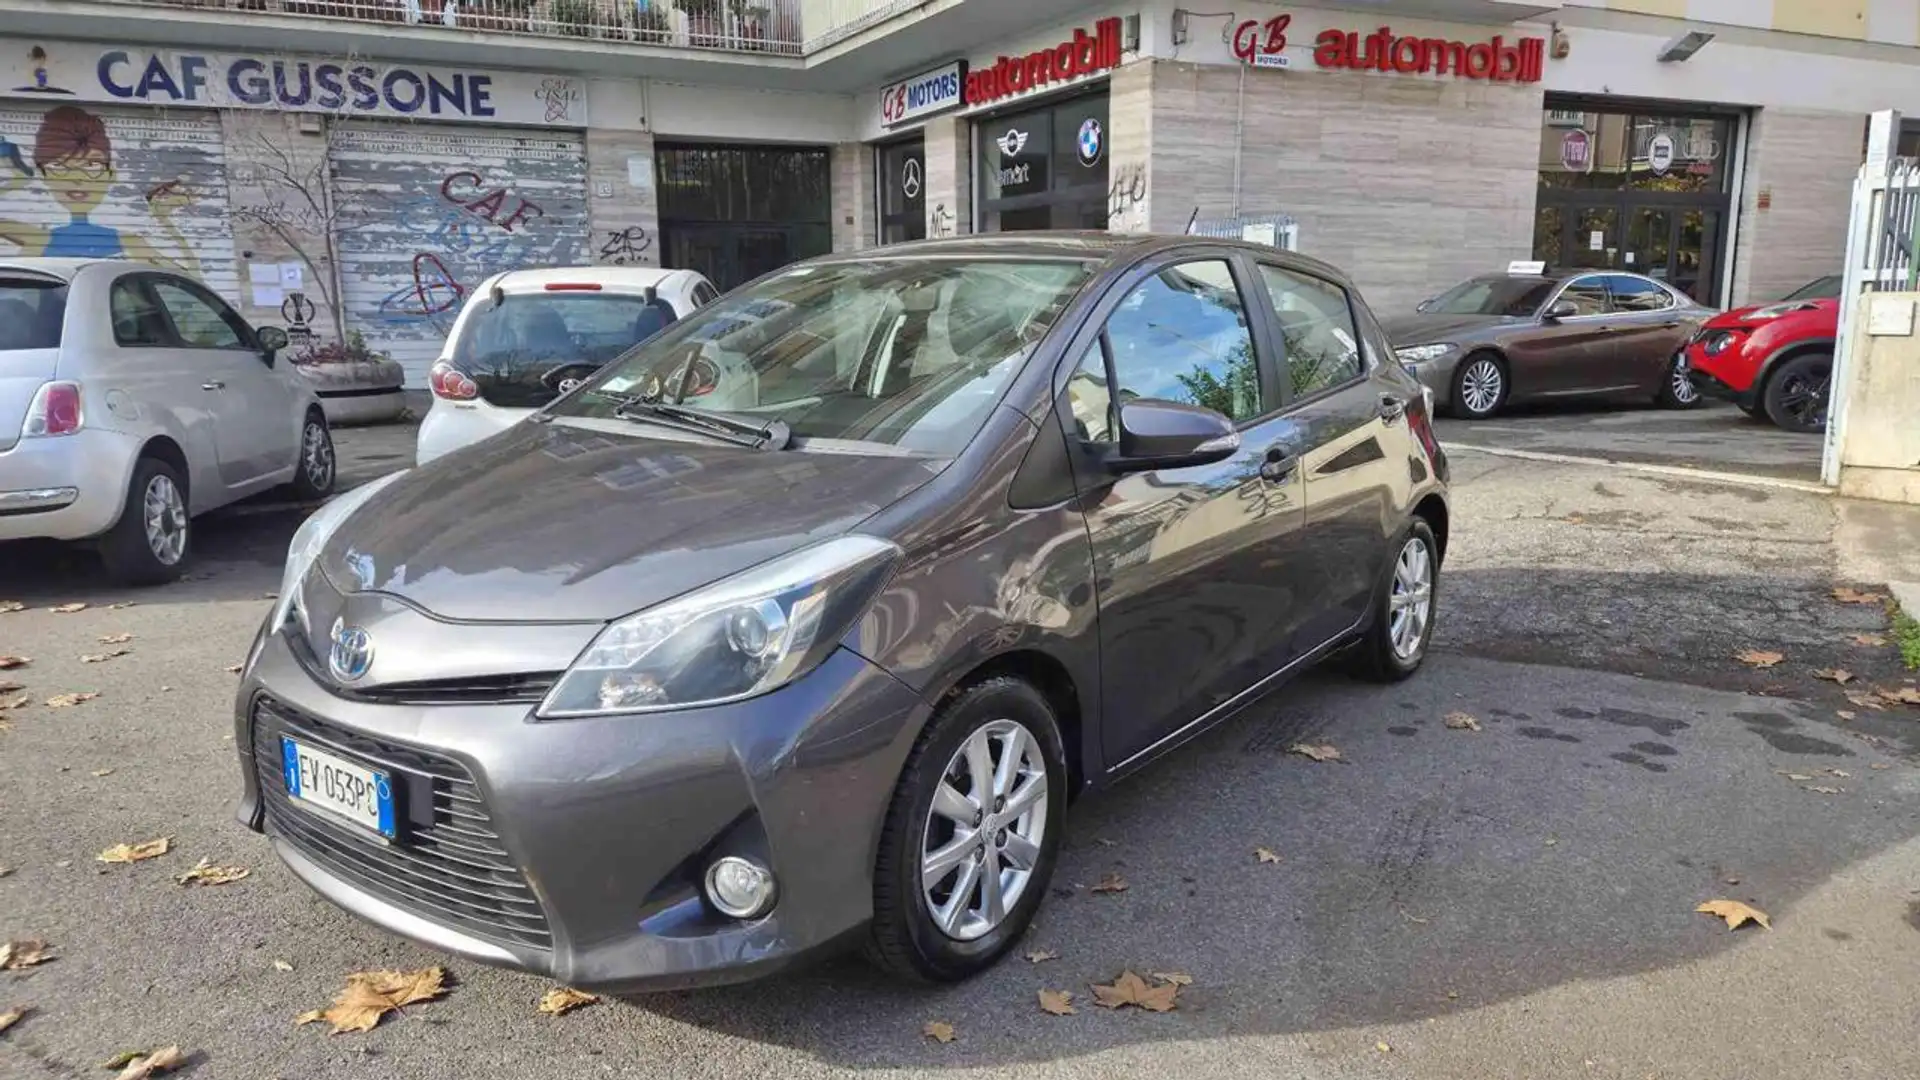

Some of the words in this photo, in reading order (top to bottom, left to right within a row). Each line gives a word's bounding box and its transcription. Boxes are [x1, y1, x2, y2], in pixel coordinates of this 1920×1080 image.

[97, 51, 207, 100] CAF
[226, 59, 496, 117] GUSSONE
[908, 72, 957, 109] MOTORS
[442, 171, 543, 232] CAF
[300, 754, 318, 793] EV
